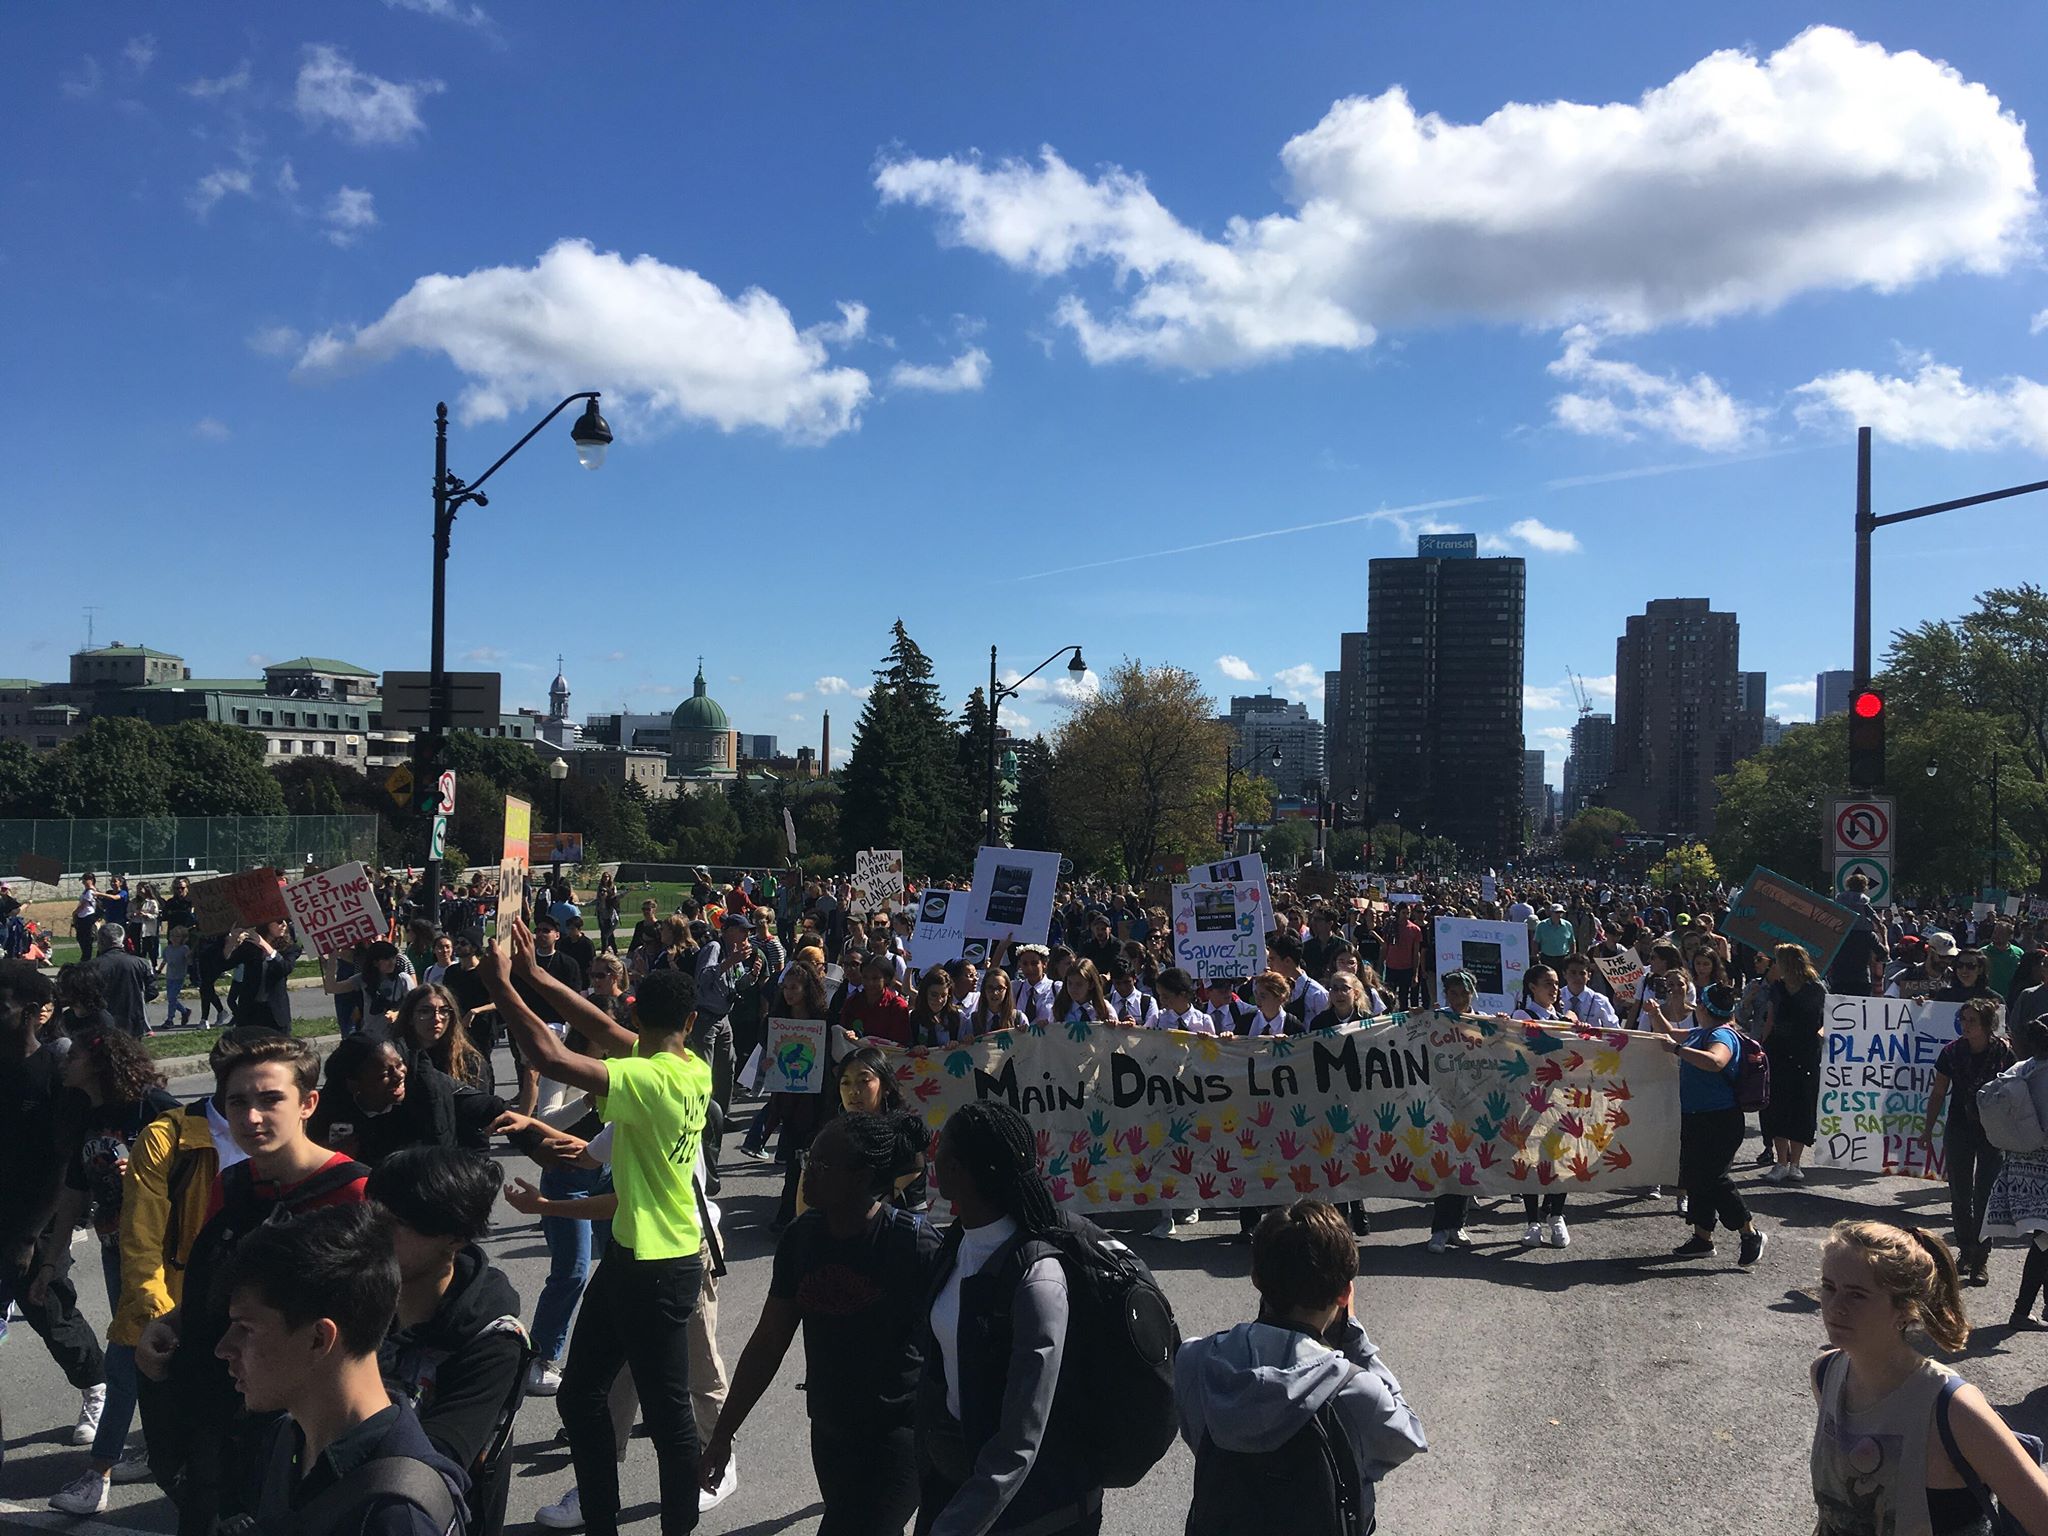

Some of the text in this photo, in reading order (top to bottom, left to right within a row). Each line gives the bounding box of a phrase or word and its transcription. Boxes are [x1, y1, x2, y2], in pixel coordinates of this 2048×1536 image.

[1436, 540, 1474, 549] transat
[287, 875, 330, 901] IT'S
[294, 877, 368, 913] GETTING
[868, 877, 884, 890] MA
[299, 904, 337, 934] HOT
[340, 895, 362, 912] IN
[313, 914, 376, 954] HERE
[1178, 938, 1236, 960] Sauvez
[1602, 962, 1637, 976] WRONG
[1603, 956, 1626, 967] THE
[1904, 980, 1951, 991] AGISSON
[1885, 1004, 1915, 1031] LA
[1825, 1062, 1945, 1093] SE RÉCHA
[1821, 1090, 1881, 1114] C'EST
[1820, 1114, 1945, 1138] SE RAPPRO
[1828, 1133, 1946, 1176] DE L'EN
